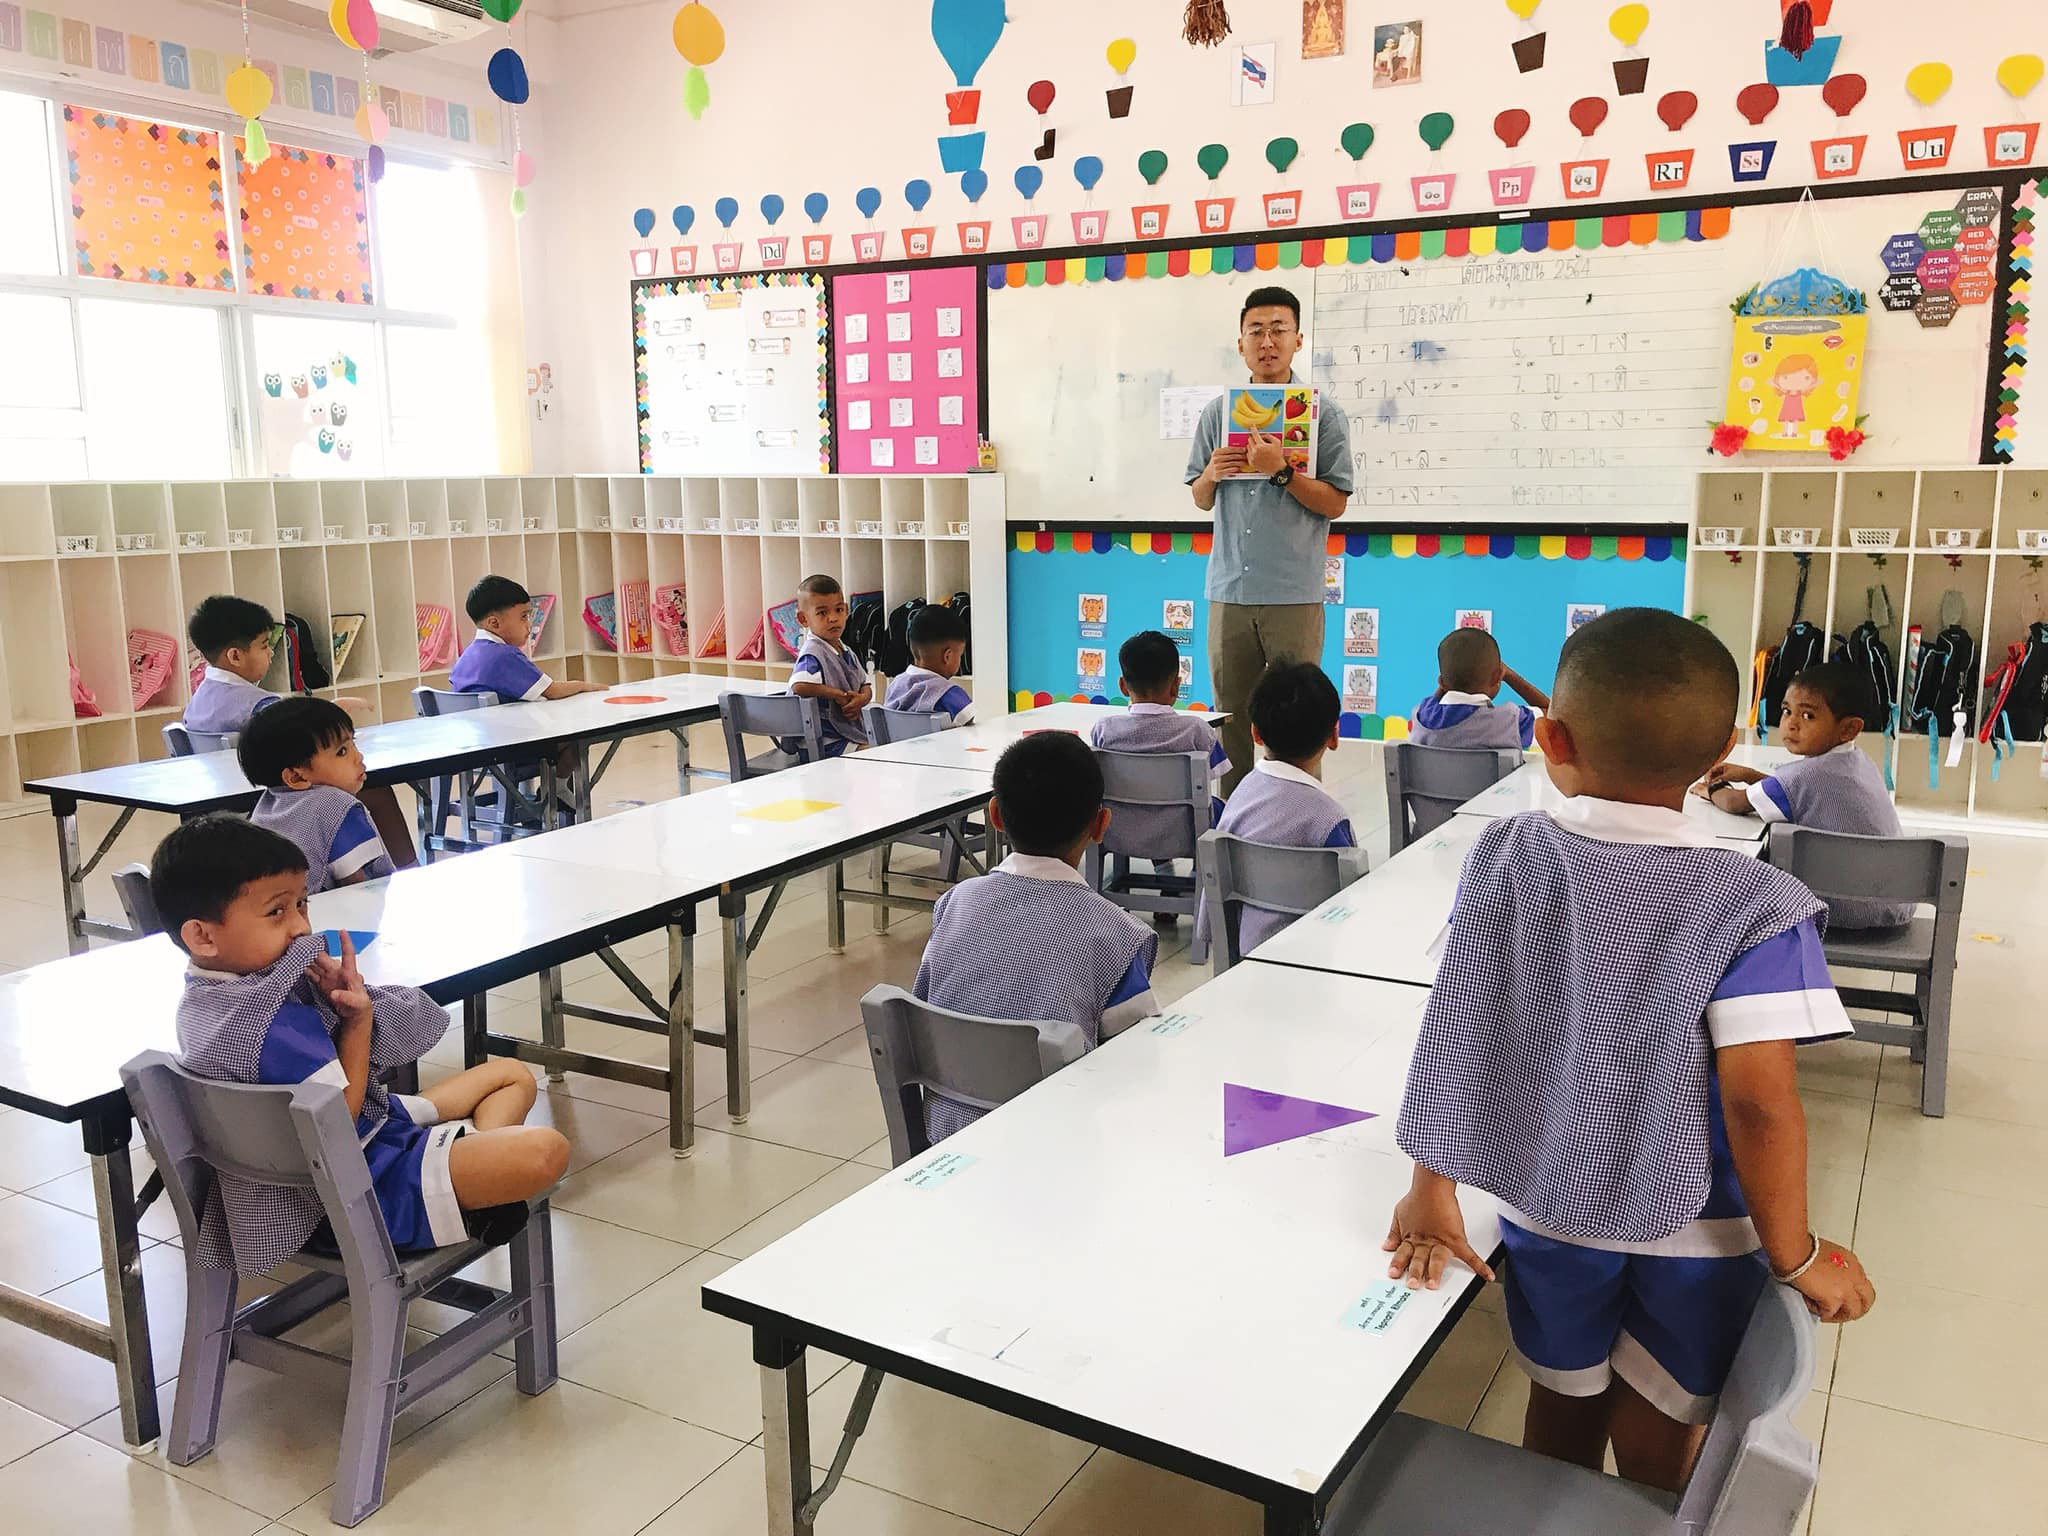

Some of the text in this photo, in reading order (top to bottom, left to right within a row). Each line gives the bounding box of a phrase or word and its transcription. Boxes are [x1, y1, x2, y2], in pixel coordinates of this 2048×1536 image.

[1910, 140, 1943, 159] Uu
[1743, 154, 1760, 169] Ss
[1656, 163, 1682, 181] Rr
[1501, 181, 1520, 196] Pp
[1967, 191, 1994, 201] GRAY
[1967, 231, 1985, 239] RED
[1892, 240, 1914, 248] BLUE
[763, 243, 782, 259] Dd
[1927, 257, 1949, 265] PINK
[1889, 276, 1919, 286] BLACK
[1733, 493, 1743, 501] 11
[1715, 532, 1726, 540] 11
